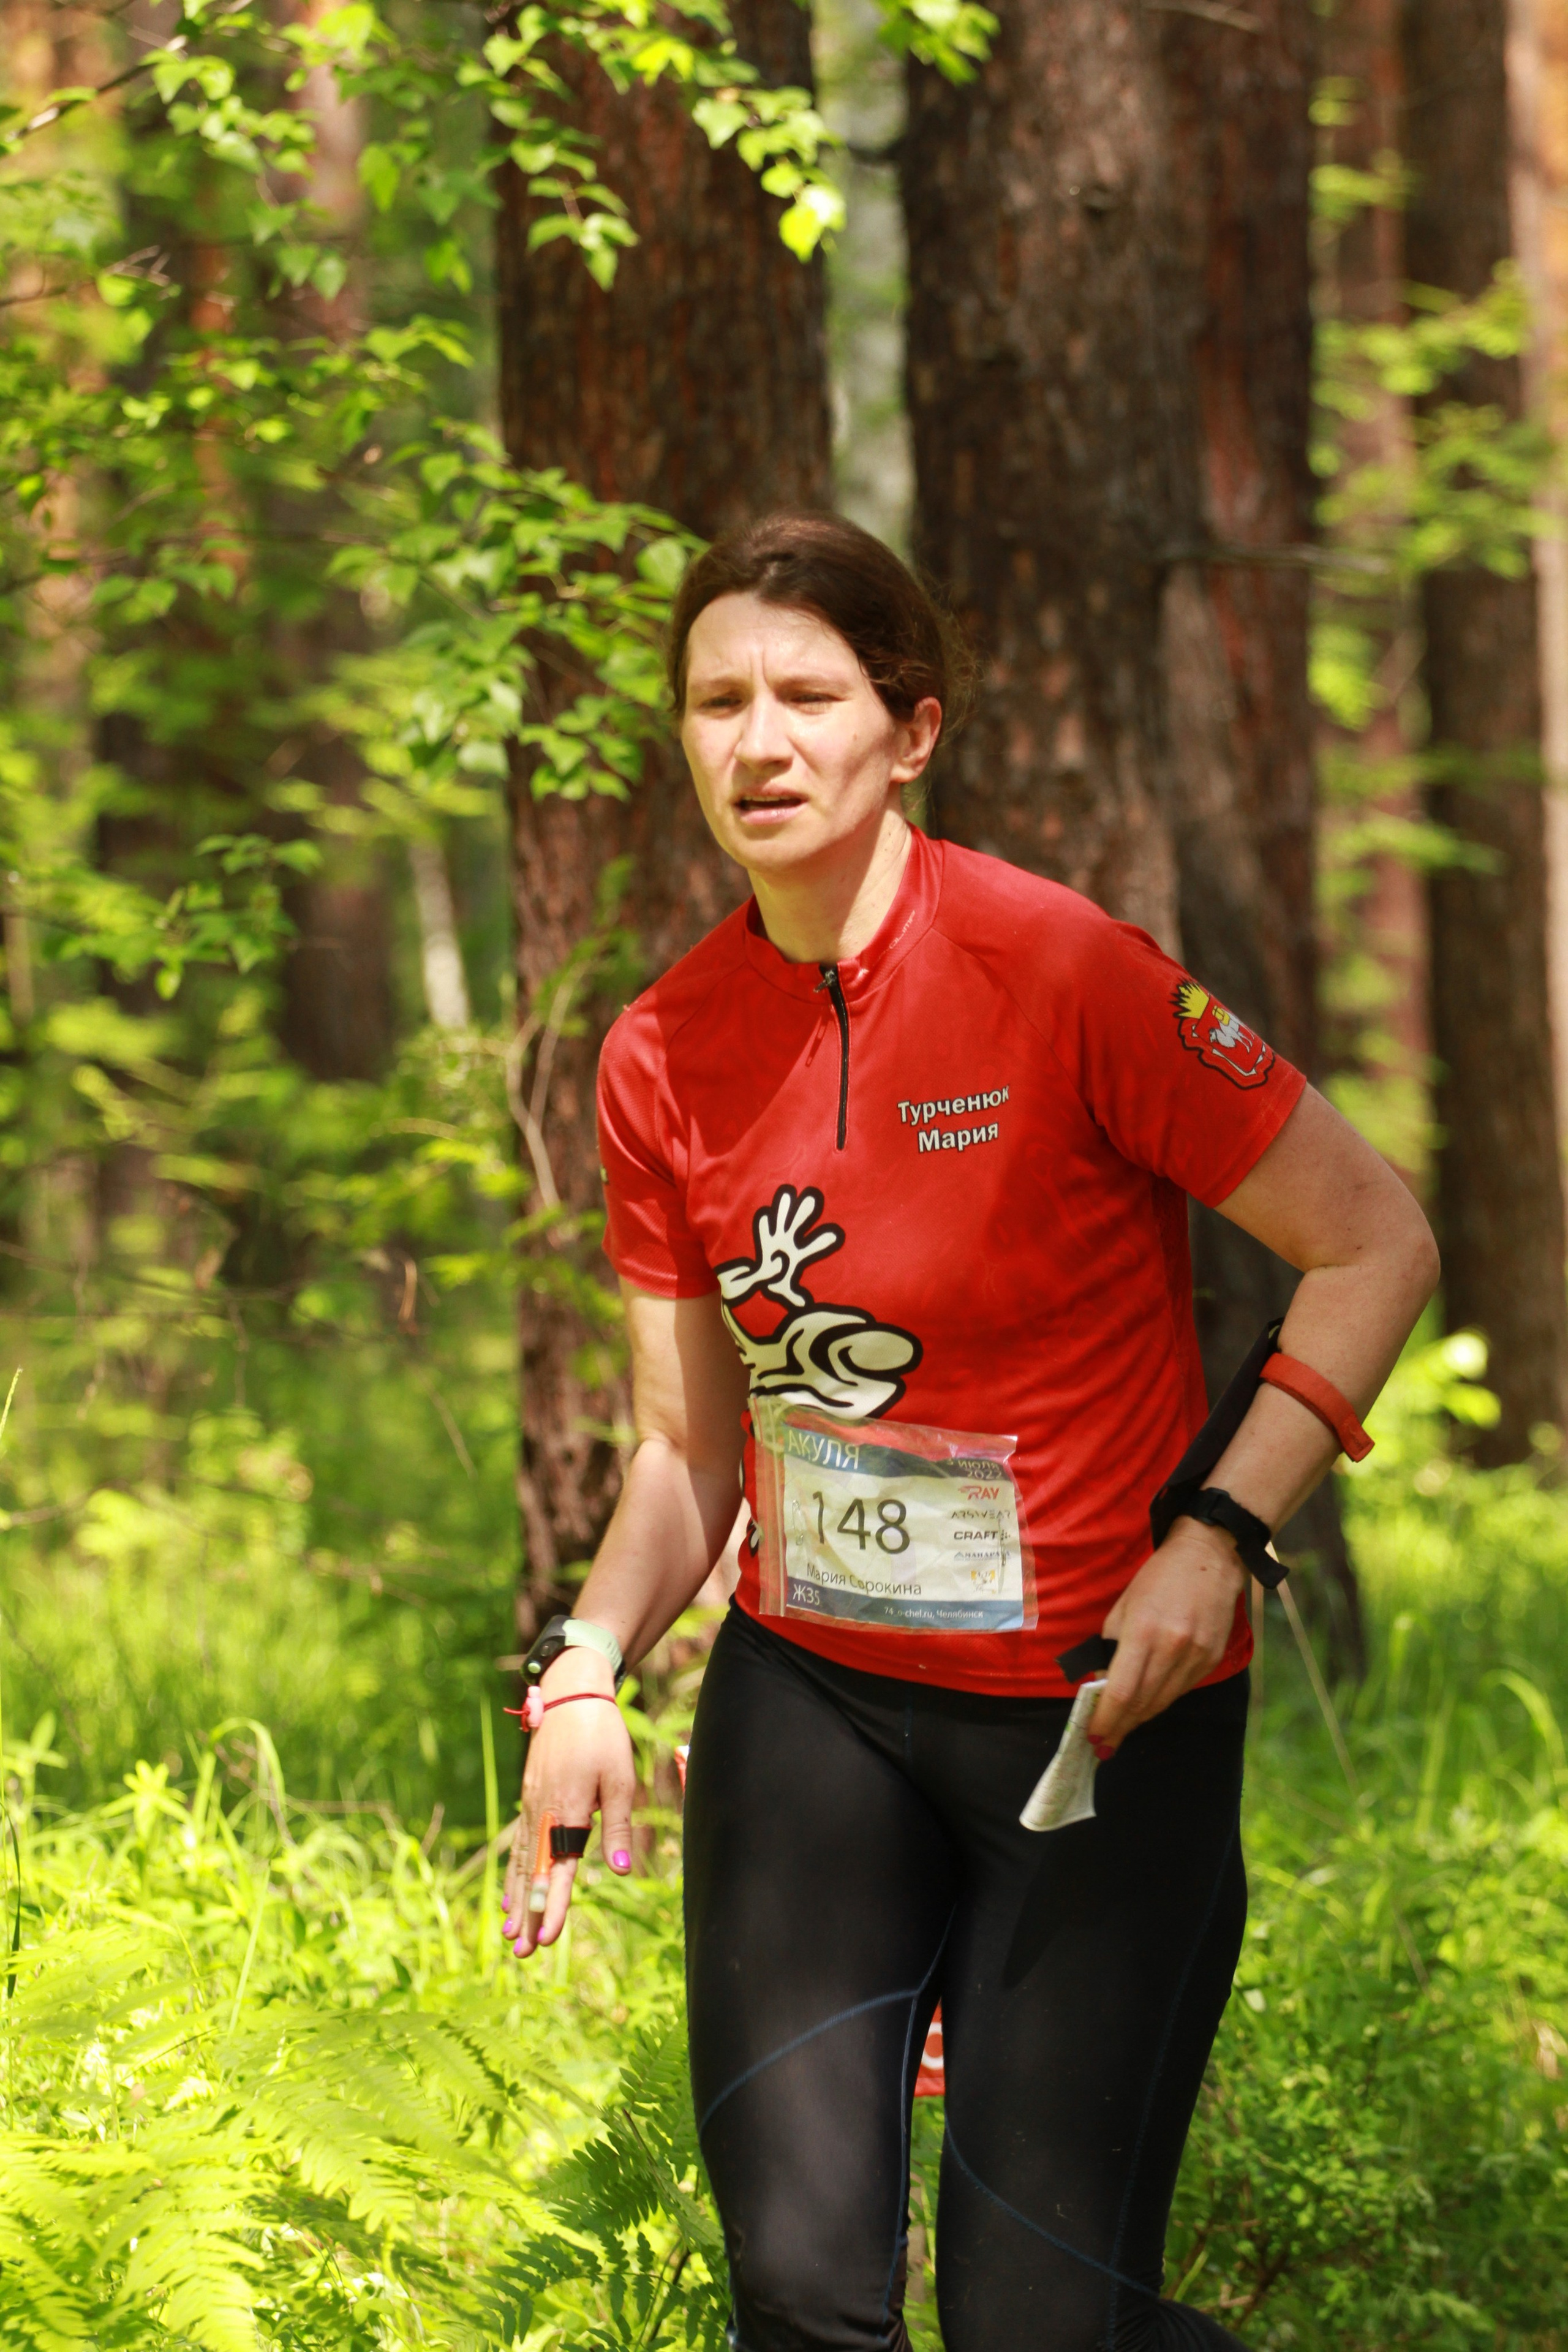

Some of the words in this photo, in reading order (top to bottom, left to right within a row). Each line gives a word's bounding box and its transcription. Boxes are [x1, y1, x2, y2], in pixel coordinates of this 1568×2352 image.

[918, 1123, 999, 1152] Мария
[788, 1429, 860, 1470] АКУЛЯ
[958, 1485, 1000, 1500] RAY
[812, 1491, 910, 1554] 148
[954, 1531, 998, 1540] CRAFT
[807, 1562, 846, 1586] Мария
[850, 1575, 922, 1596] Сорокина
[793, 1583, 820, 1605] Ж35
[937, 1608, 984, 1619] Челябинск
